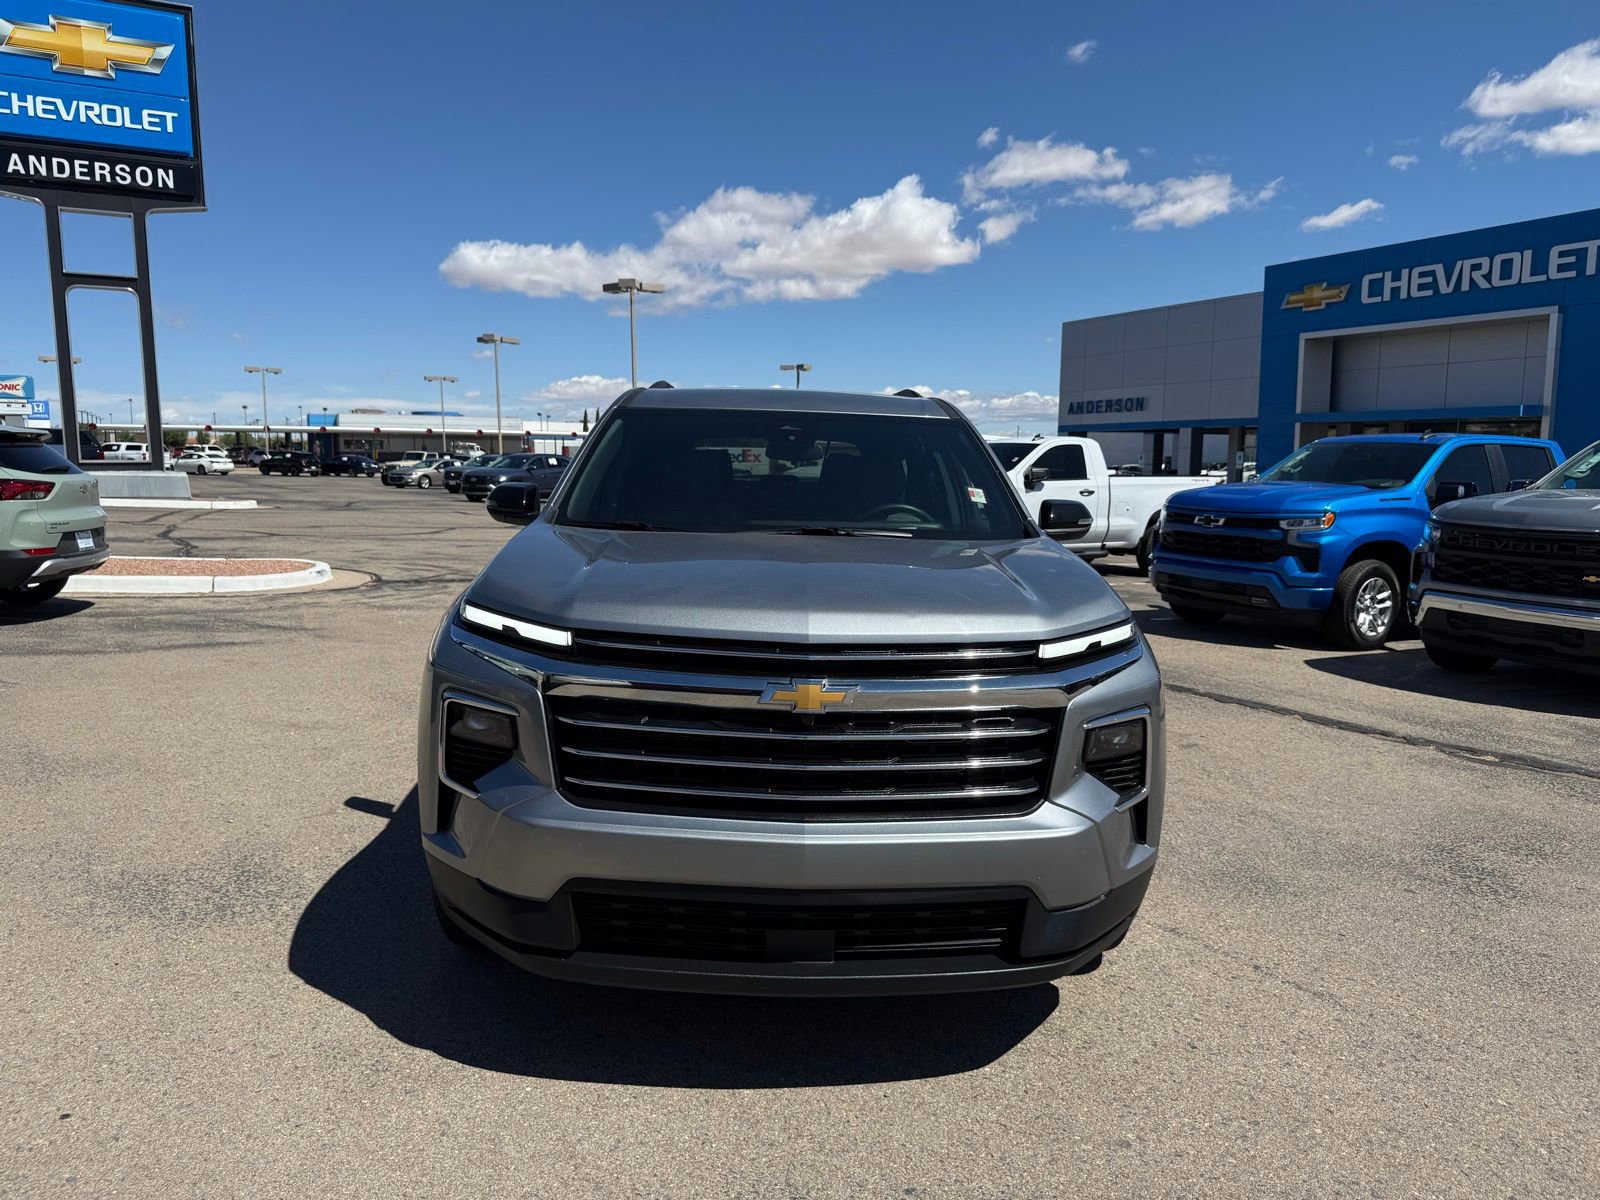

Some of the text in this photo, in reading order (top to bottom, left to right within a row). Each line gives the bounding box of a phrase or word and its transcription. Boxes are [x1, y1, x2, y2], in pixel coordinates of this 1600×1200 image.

[7, 153, 175, 189] ANDERSON
[1361, 239, 1600, 304] CHEVROLET
[1067, 397, 1146, 415] ANDERSON
[728, 449, 761, 463] edEx
